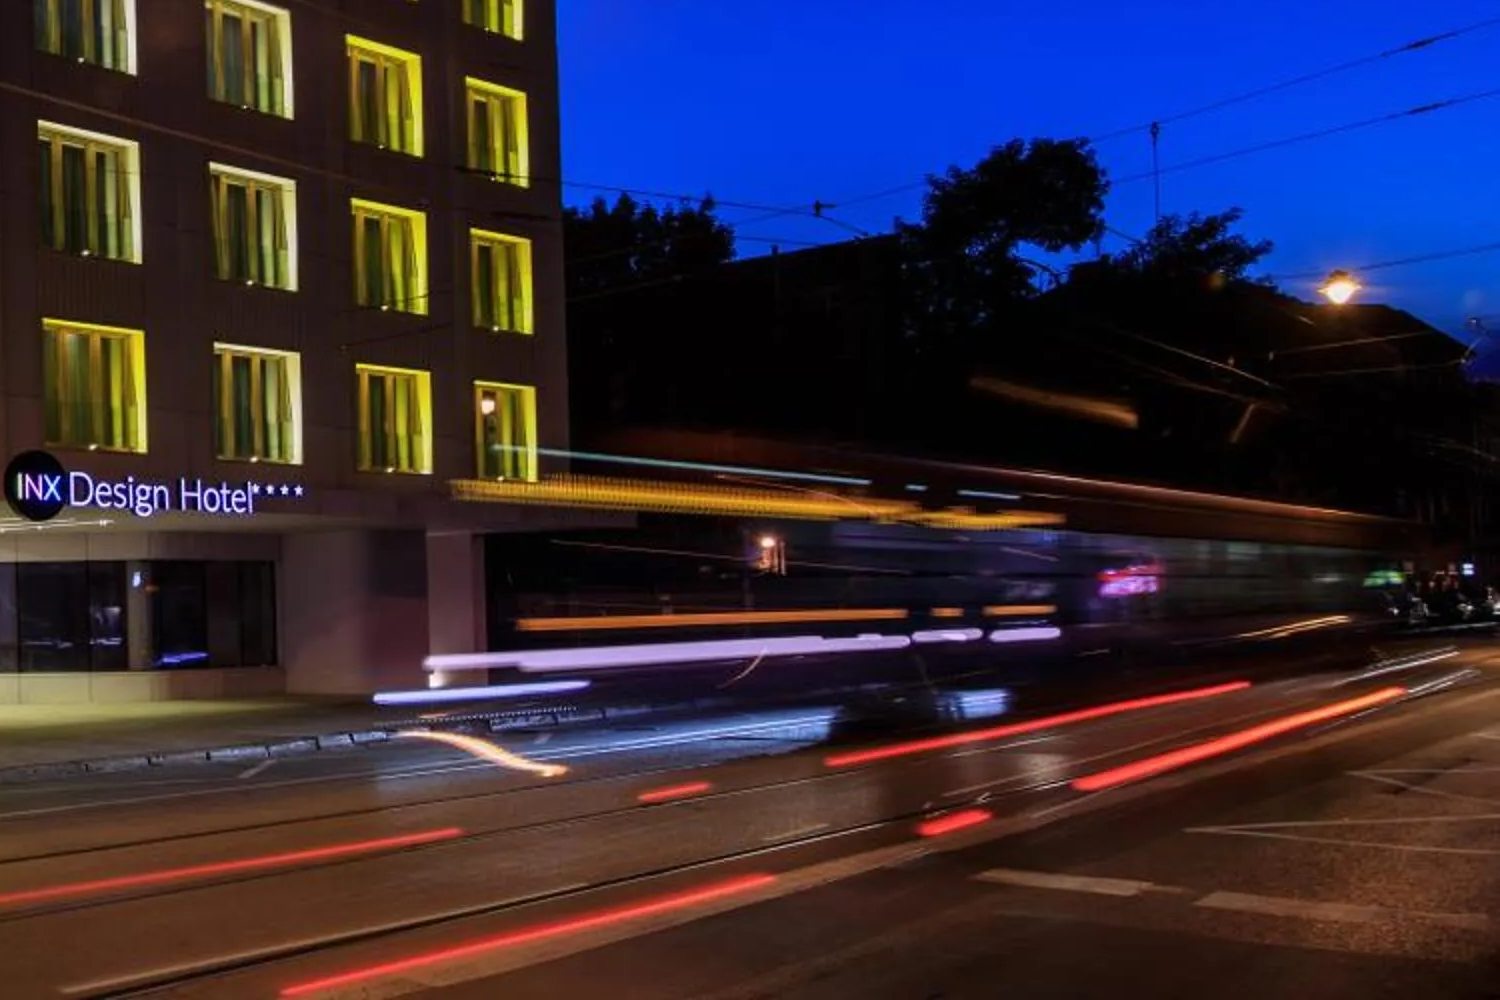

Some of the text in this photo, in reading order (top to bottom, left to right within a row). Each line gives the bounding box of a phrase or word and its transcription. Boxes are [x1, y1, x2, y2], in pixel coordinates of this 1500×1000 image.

[16, 471, 254, 518] INX Design Hotel
